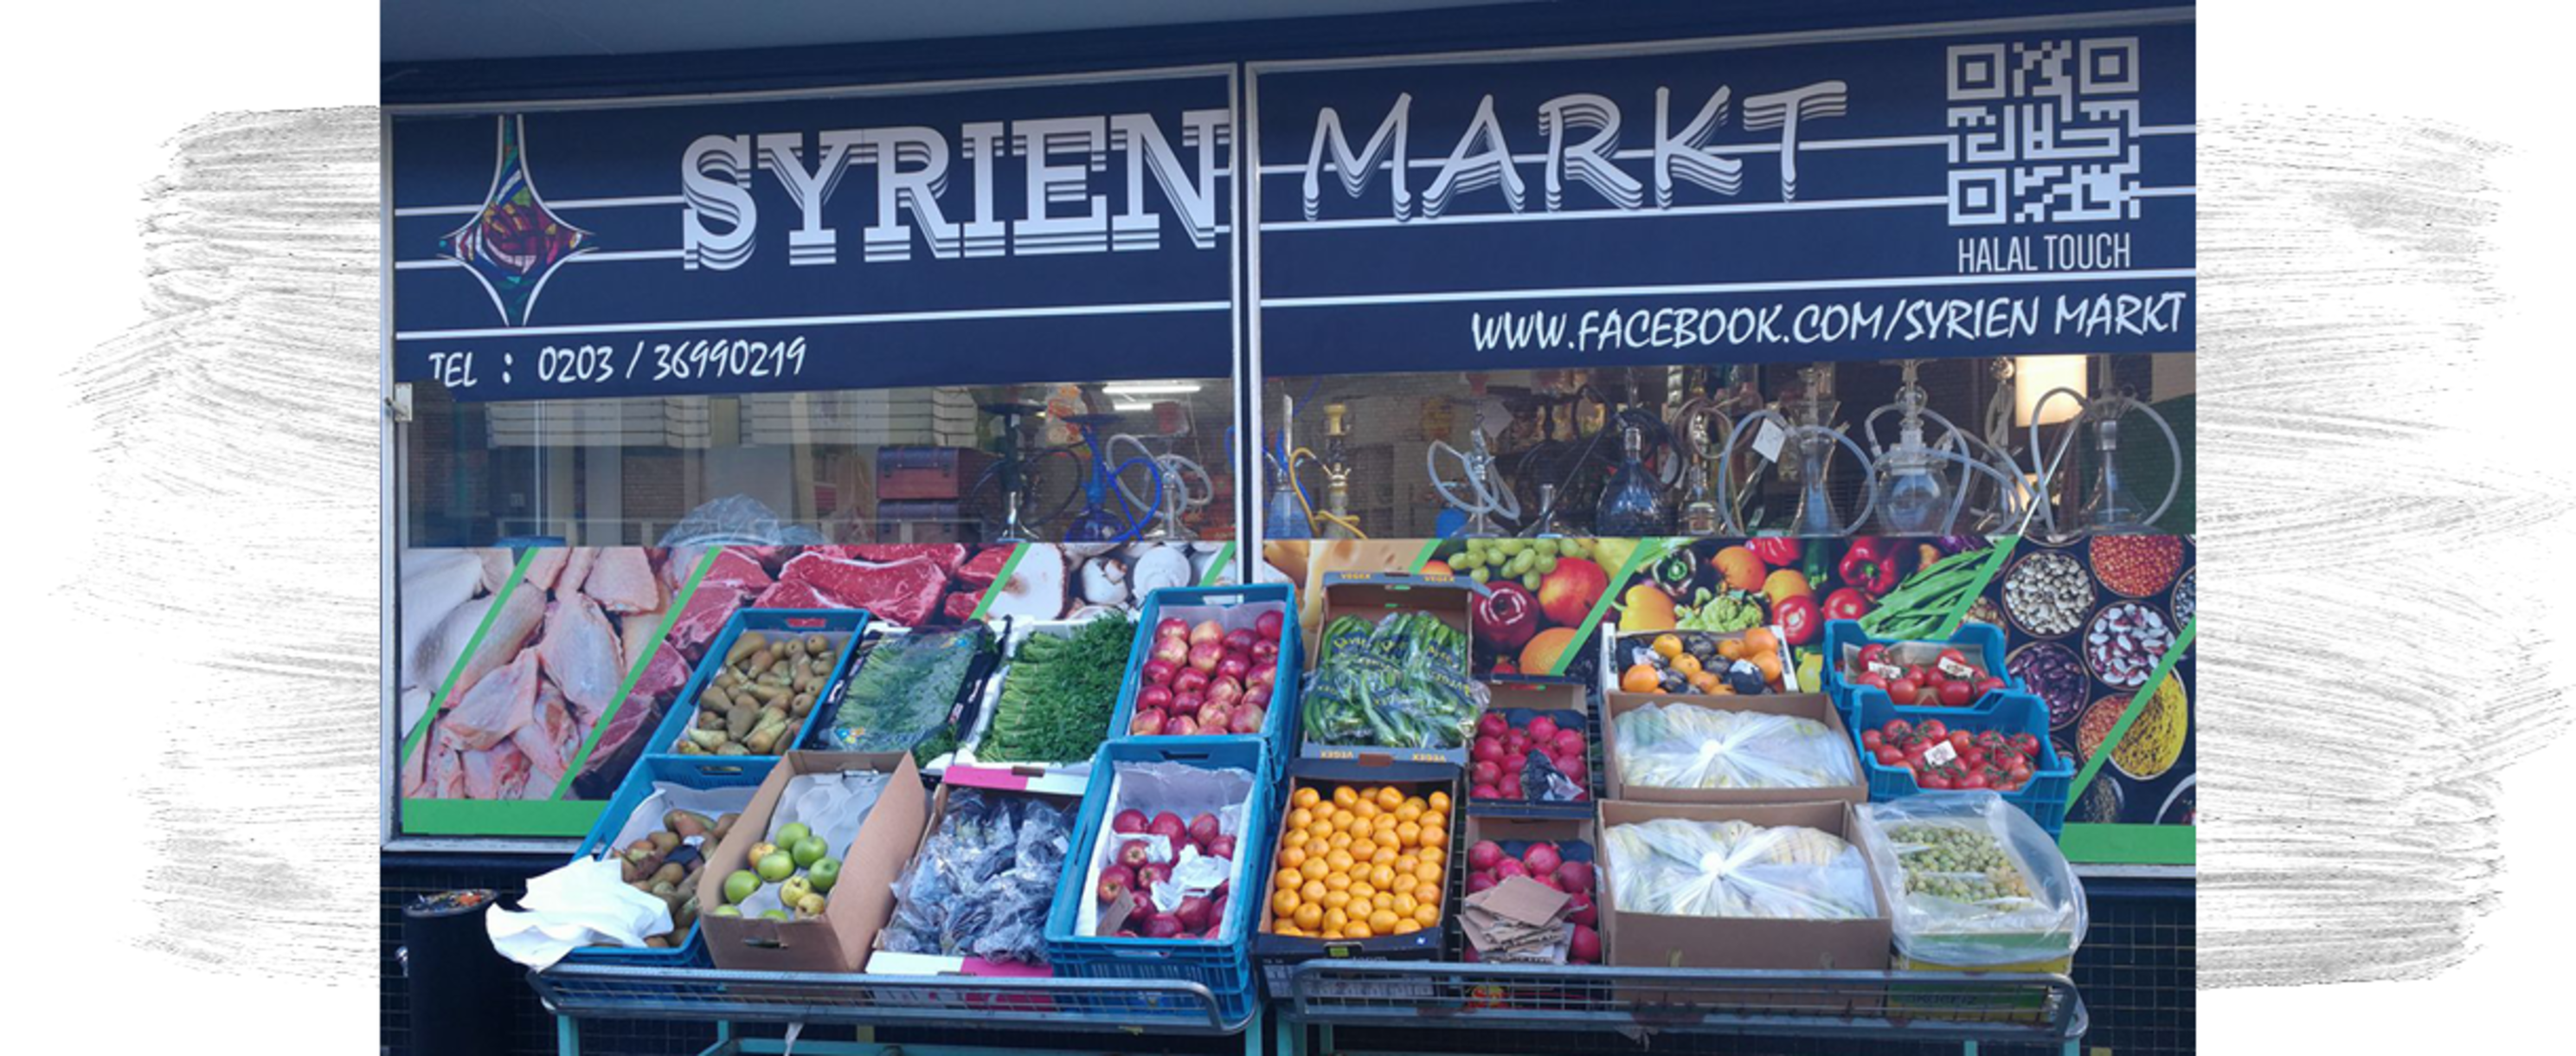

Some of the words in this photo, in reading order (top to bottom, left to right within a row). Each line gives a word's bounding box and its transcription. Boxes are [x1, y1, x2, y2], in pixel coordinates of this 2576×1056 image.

[681, 107, 1230, 271] SYRIEN
[1302, 80, 1847, 222] MARKT
[1958, 235, 2039, 274] HALAL
[2043, 232, 2130, 271] TOUCH
[1471, 295, 2040, 351] WWW.FACEBOOK.COM/SYRIEN
[2054, 291, 2187, 338] MARKT
[428, 351, 478, 388] TEL
[537, 346, 614, 383] 0203
[625, 341, 645, 380] /
[652, 336, 806, 382] 36990219
